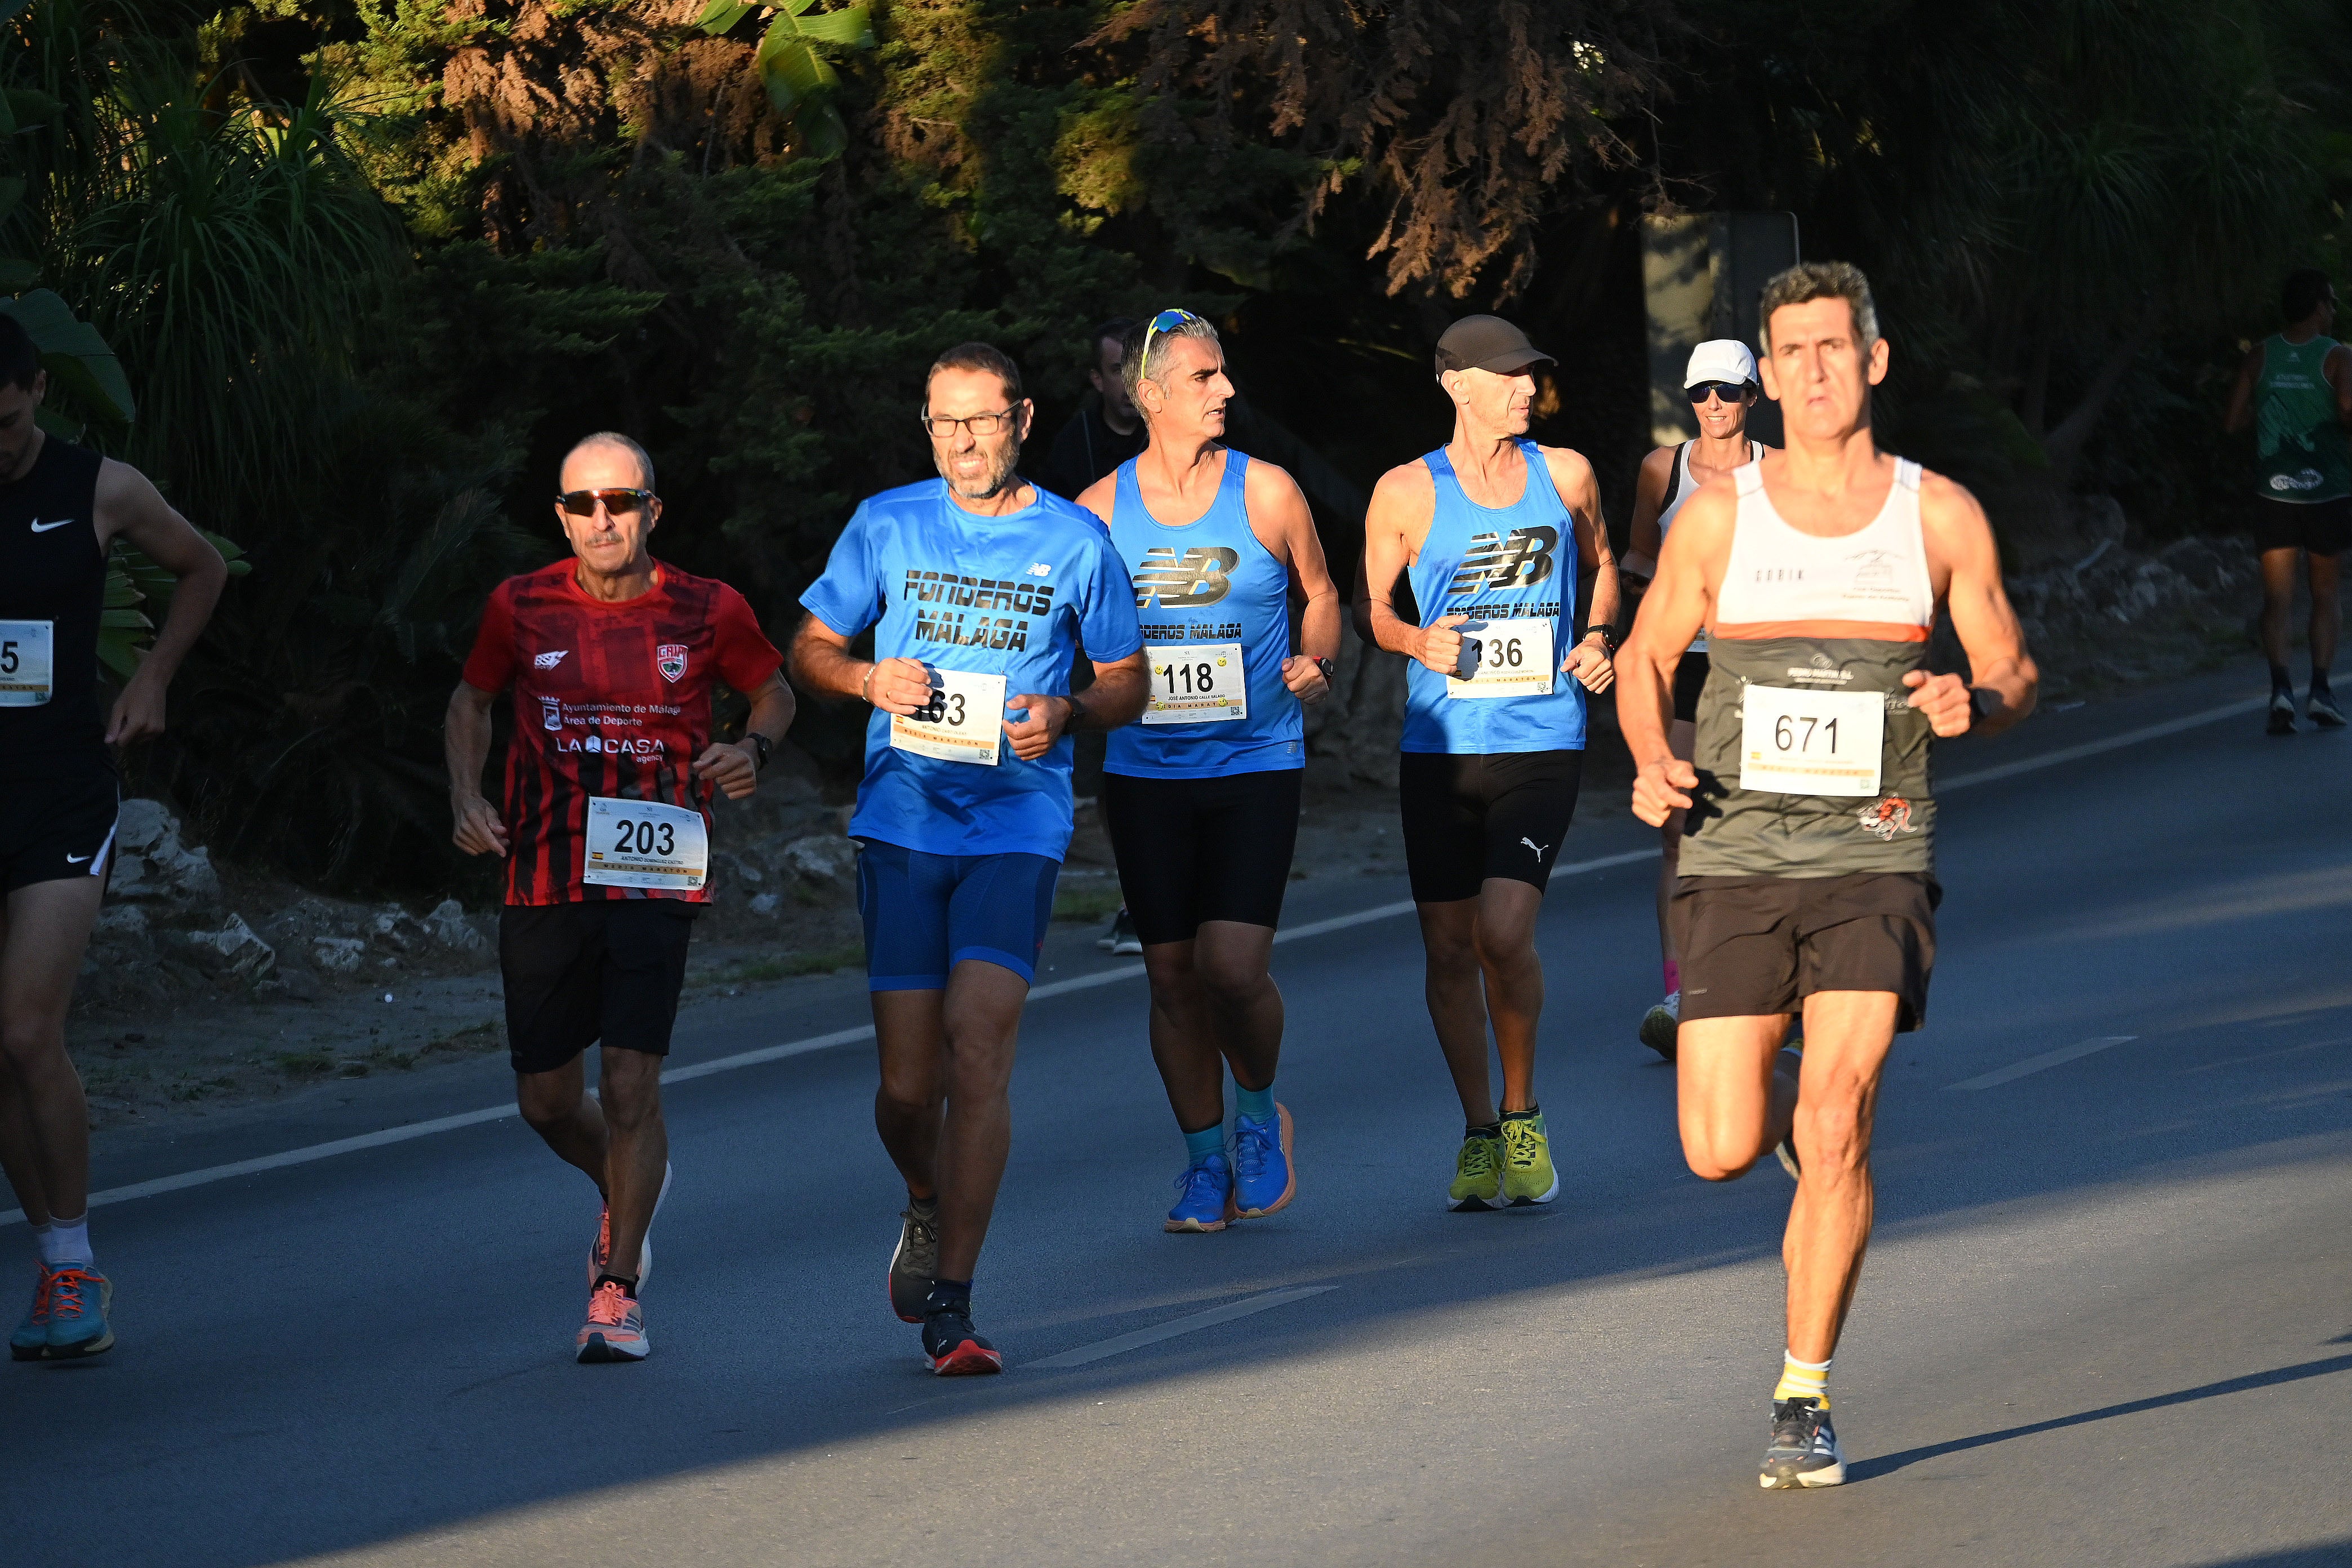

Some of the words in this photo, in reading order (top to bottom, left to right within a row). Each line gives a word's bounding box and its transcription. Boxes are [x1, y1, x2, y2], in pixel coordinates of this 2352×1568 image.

[903, 569, 1055, 616] FONDEROS
[1512, 602, 1560, 617] MALAGA
[915, 609, 1028, 652] MALAGA
[1190, 623, 1242, 639] MALAGA
[1471, 638, 1522, 668] 136
[1163, 663, 1214, 694] 118
[563, 703, 631, 713] Ayuntamiento
[633, 704, 647, 713] de
[564, 715, 586, 725] Área
[588, 716, 601, 724] de
[603, 715, 643, 727] Deporte
[556, 737, 582, 752] LA
[604, 738, 665, 754] CASA
[1775, 715, 1838, 754] 671
[636, 754, 663, 764] agency
[614, 819, 675, 856] 203
